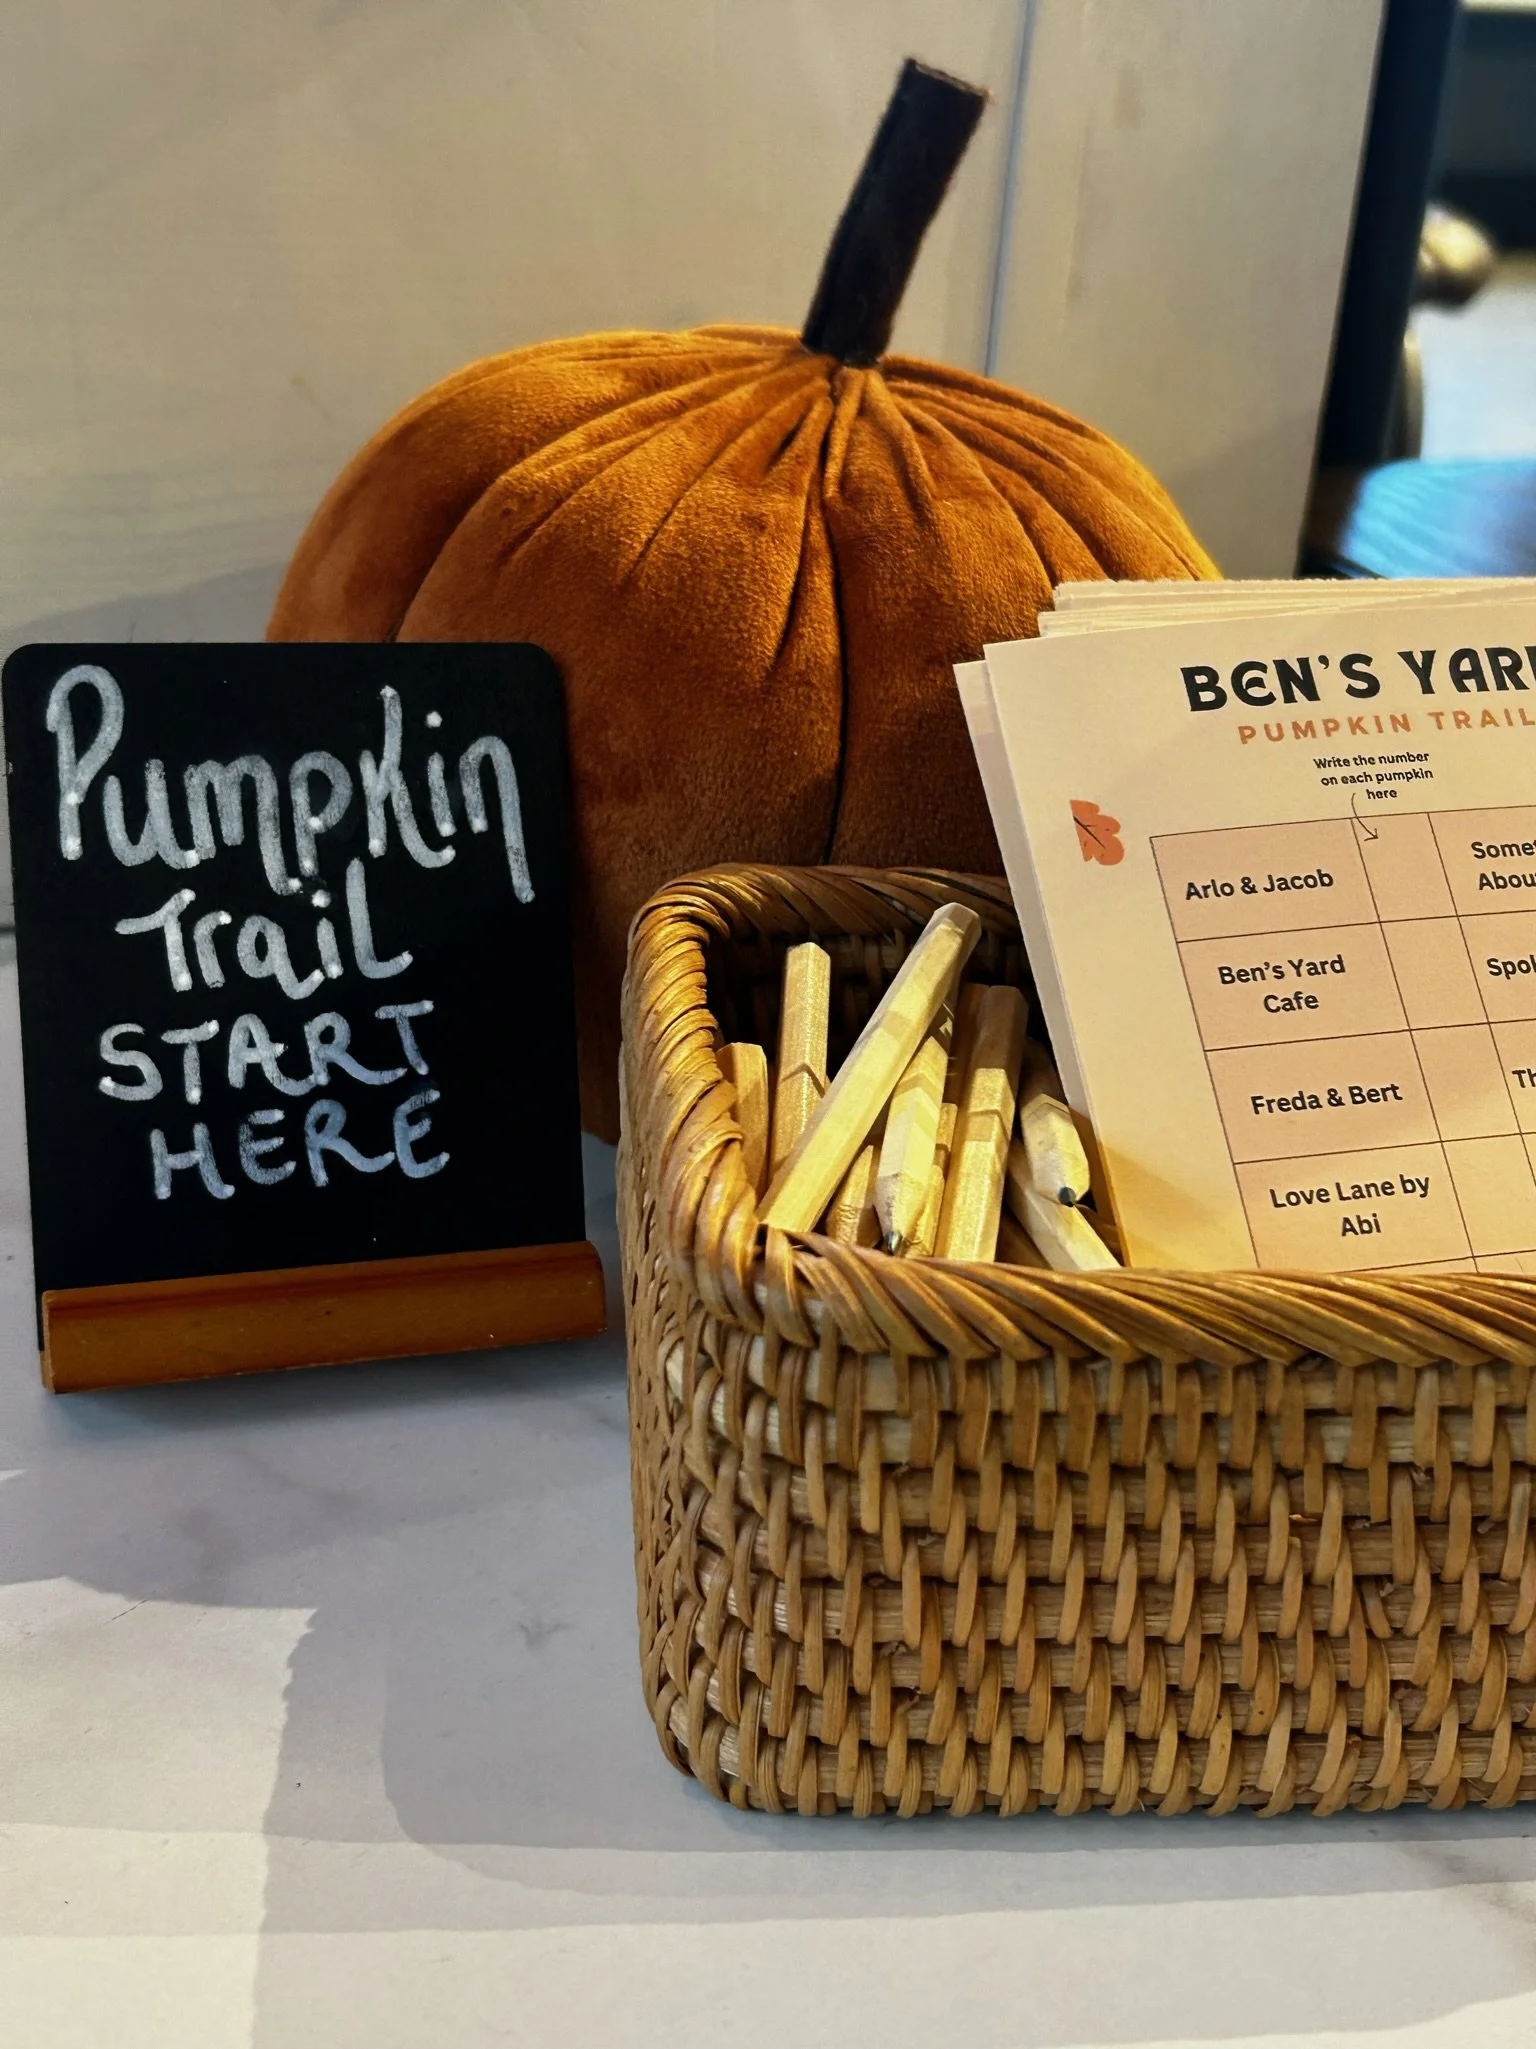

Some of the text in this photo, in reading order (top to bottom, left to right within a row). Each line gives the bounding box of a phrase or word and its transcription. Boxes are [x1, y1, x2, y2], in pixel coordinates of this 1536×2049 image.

[1180, 653, 1381, 712] BEN'S
[1238, 707, 1536, 745] PUMPKIN TRAIL
[1312, 751, 1430, 769] Write the number
[1320, 767, 1434, 786] on each pumpkin
[46, 664, 535, 903] Pumpkin
[1366, 789, 1398, 800] here
[1185, 868, 1335, 901] Arlo & Jacob
[1479, 871, 1536, 891] Abou
[1218, 954, 1347, 986] Ben's Yard
[1263, 991, 1320, 1014] Cafe
[98, 1000, 435, 1105] START
[1250, 1082, 1404, 1116] Freda & Bert
[149, 1088, 451, 1200] HERE
[1269, 1173, 1431, 1209] Love Lane by
[1340, 1212, 1382, 1237] Abi
